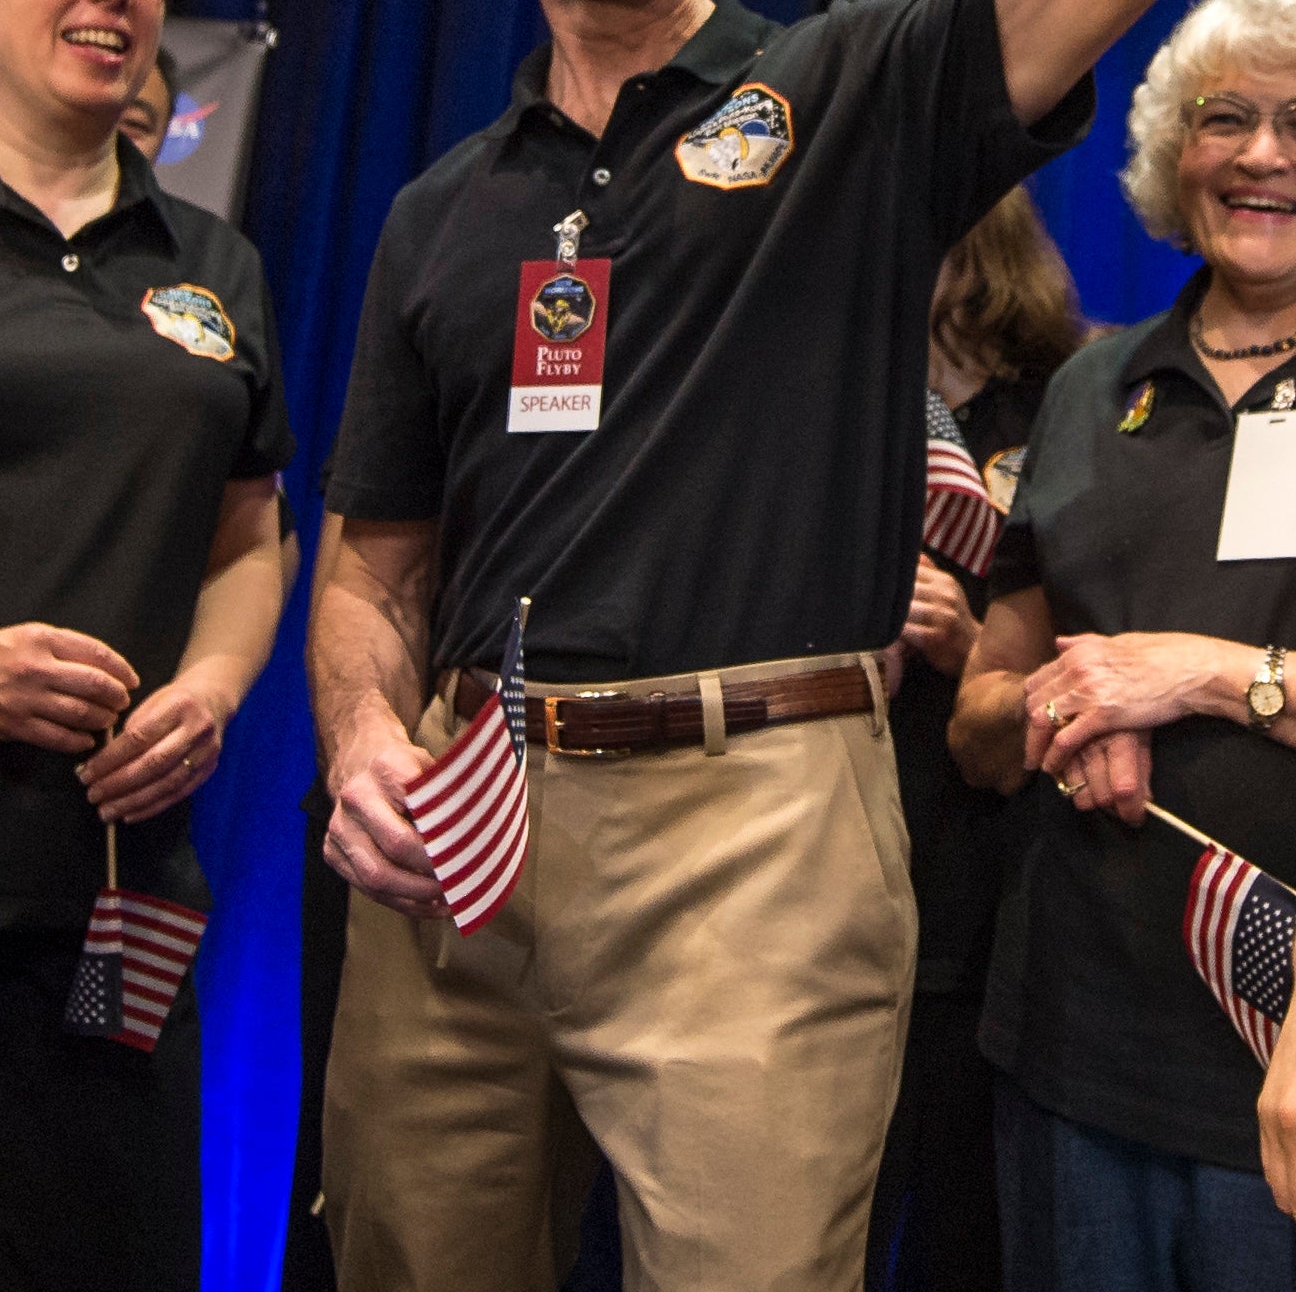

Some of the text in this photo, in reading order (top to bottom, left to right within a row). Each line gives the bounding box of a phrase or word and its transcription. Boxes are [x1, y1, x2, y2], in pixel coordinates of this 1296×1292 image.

[537, 345, 582, 363] PLUTO
[536, 361, 581, 377] FLYBY
[520, 395, 591, 413] SPEAKER
